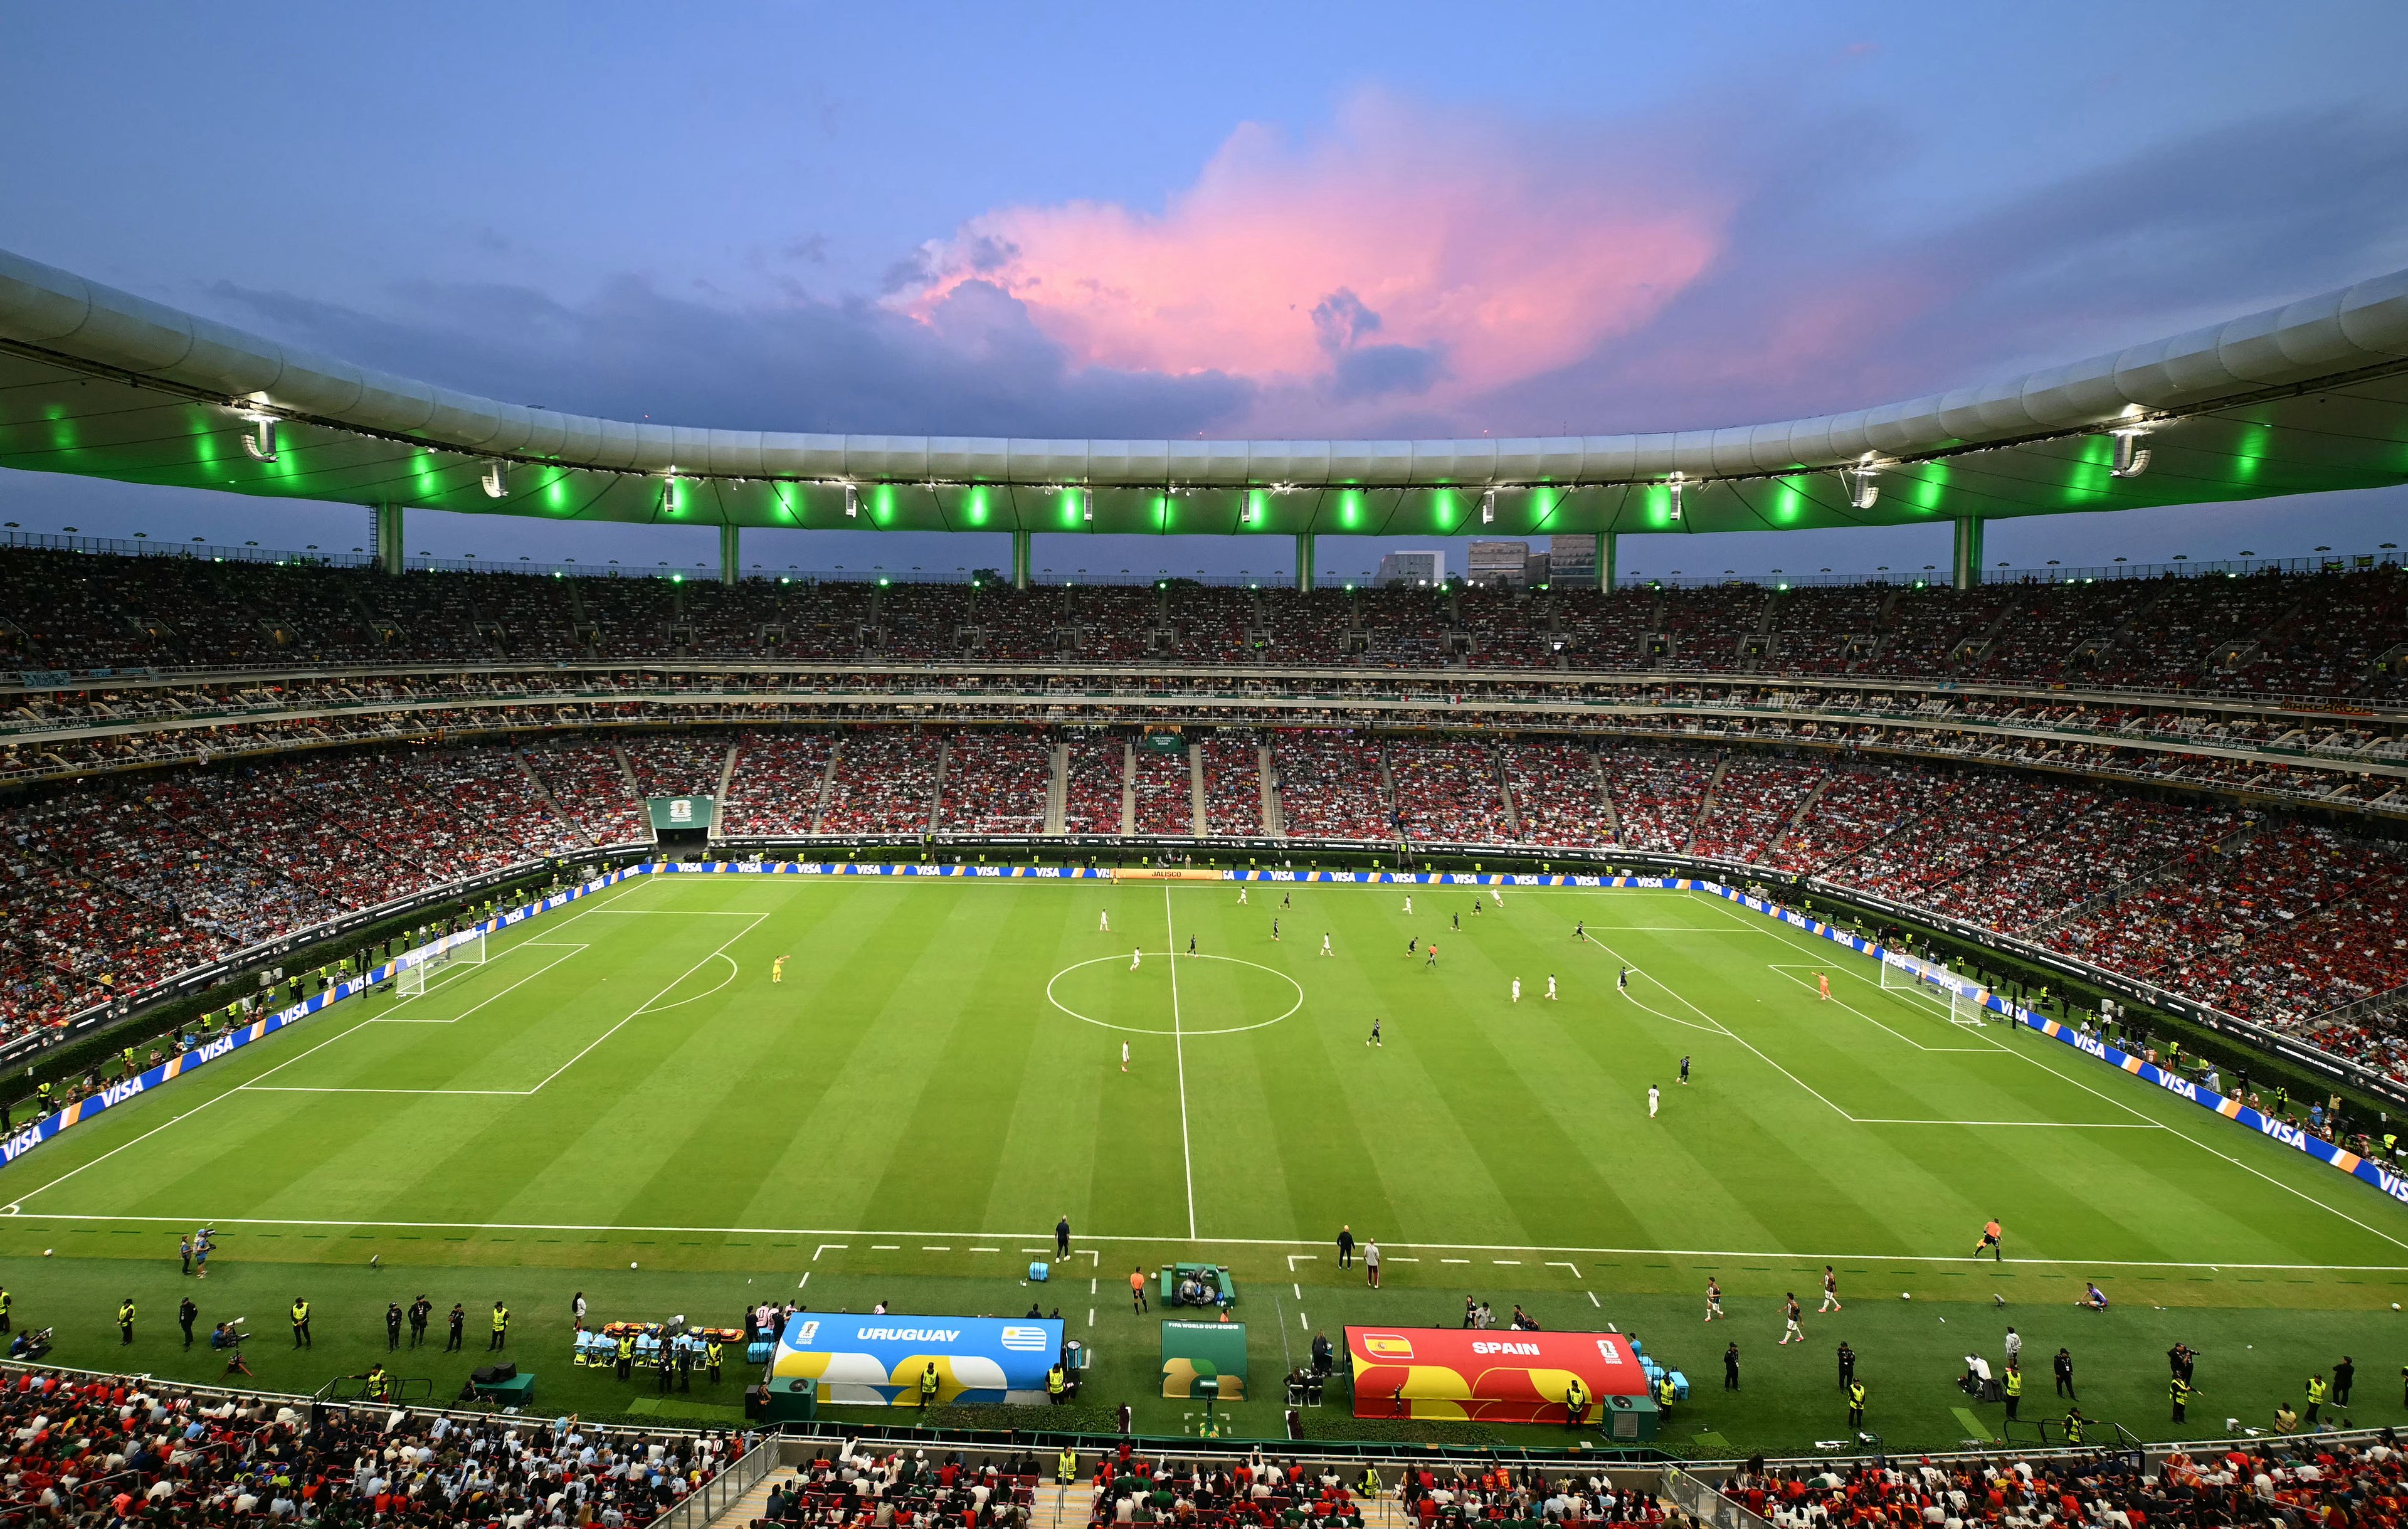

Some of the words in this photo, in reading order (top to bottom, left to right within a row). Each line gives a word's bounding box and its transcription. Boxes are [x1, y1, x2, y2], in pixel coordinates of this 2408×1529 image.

[19, 723, 90, 734] GUADALAJARA
[1997, 722, 2055, 731] GUADALAJARA
[623, 865, 639, 878] VISA
[677, 863, 702, 873] VISA
[736, 863, 763, 874] VISA
[796, 864, 821, 874] VISA
[856, 865, 881, 875] VISA
[916, 866, 941, 876] VISA
[975, 867, 1000, 877] VISA
[1035, 867, 1060, 878] VISA
[1270, 871, 1295, 882] VISA
[1329, 872, 1356, 882] VISA
[1391, 873, 1417, 883] VISA
[1451, 874, 1477, 884] VISA
[1513, 875, 1539, 886] VISA
[1573, 876, 1600, 887] VISA
[1636, 877, 1664, 888] VISA
[1703, 881, 1723, 896] VISA
[1744, 896, 1762, 911] VISA
[1785, 911, 1806, 928] VISA
[1832, 929, 1853, 947] VISA
[406, 947, 428, 967] VISA
[277, 1001, 310, 1026] VISA
[197, 1035, 234, 1062] VISA
[2071, 1030, 2106, 1059] VISA
[2156, 1067, 2197, 1101] VISA
[98, 1076, 144, 1108] VISA
[2258, 1114, 2306, 1151] VISA
[2, 1125, 42, 1161] VISA
[2376, 1166, 2408, 1204] VIS
[857, 1328, 961, 1342] URUGUAY
[1472, 1342, 1541, 1355] SPAIN
[433, 1422, 441, 1432] 18
[714, 1441, 722, 1451] 10
[356, 1474, 362, 1485] 5
[1500, 1476, 1509, 1488] 19
[1959, 1496, 1967, 1508] 3
